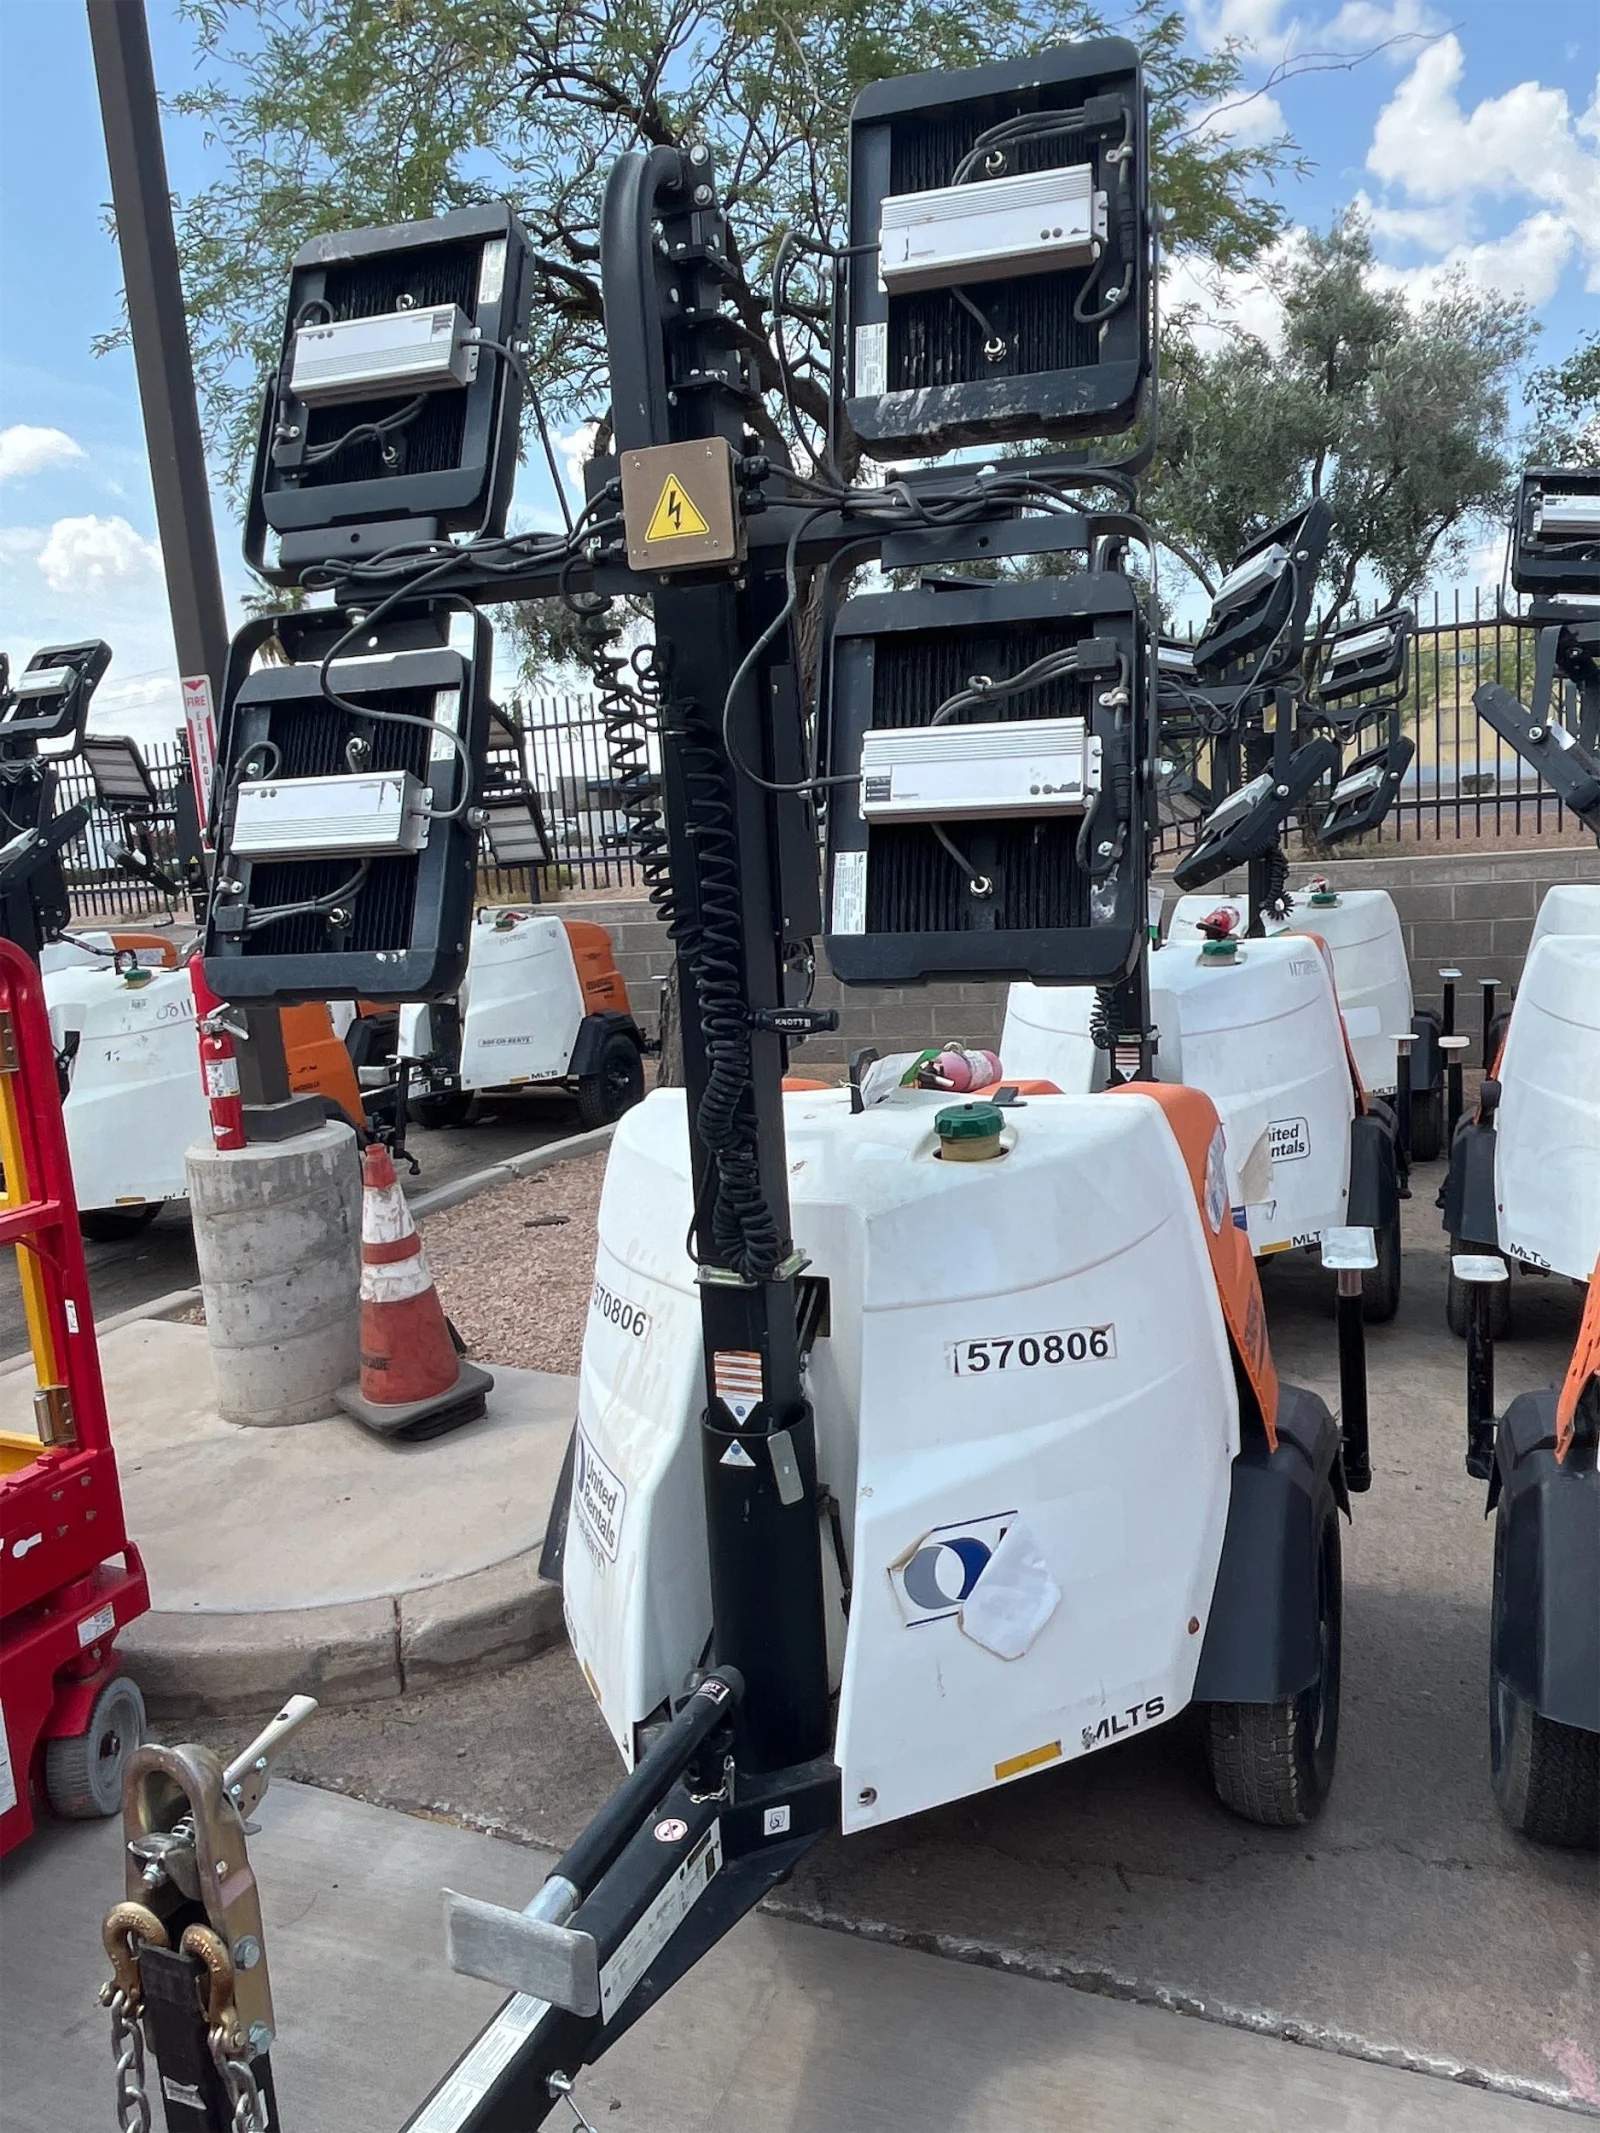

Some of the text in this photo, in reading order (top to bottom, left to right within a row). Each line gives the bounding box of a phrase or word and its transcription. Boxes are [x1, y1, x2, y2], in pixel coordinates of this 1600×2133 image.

[186, 695, 207, 707] FIRE
[774, 1018, 804, 1026] KNOTT
[1270, 1138, 1306, 1158] ntals
[1291, 1230, 1321, 1247] MLT
[967, 1330, 1109, 1373] 570806
[586, 1452, 618, 1516] United
[583, 1481, 616, 1549] Rentals
